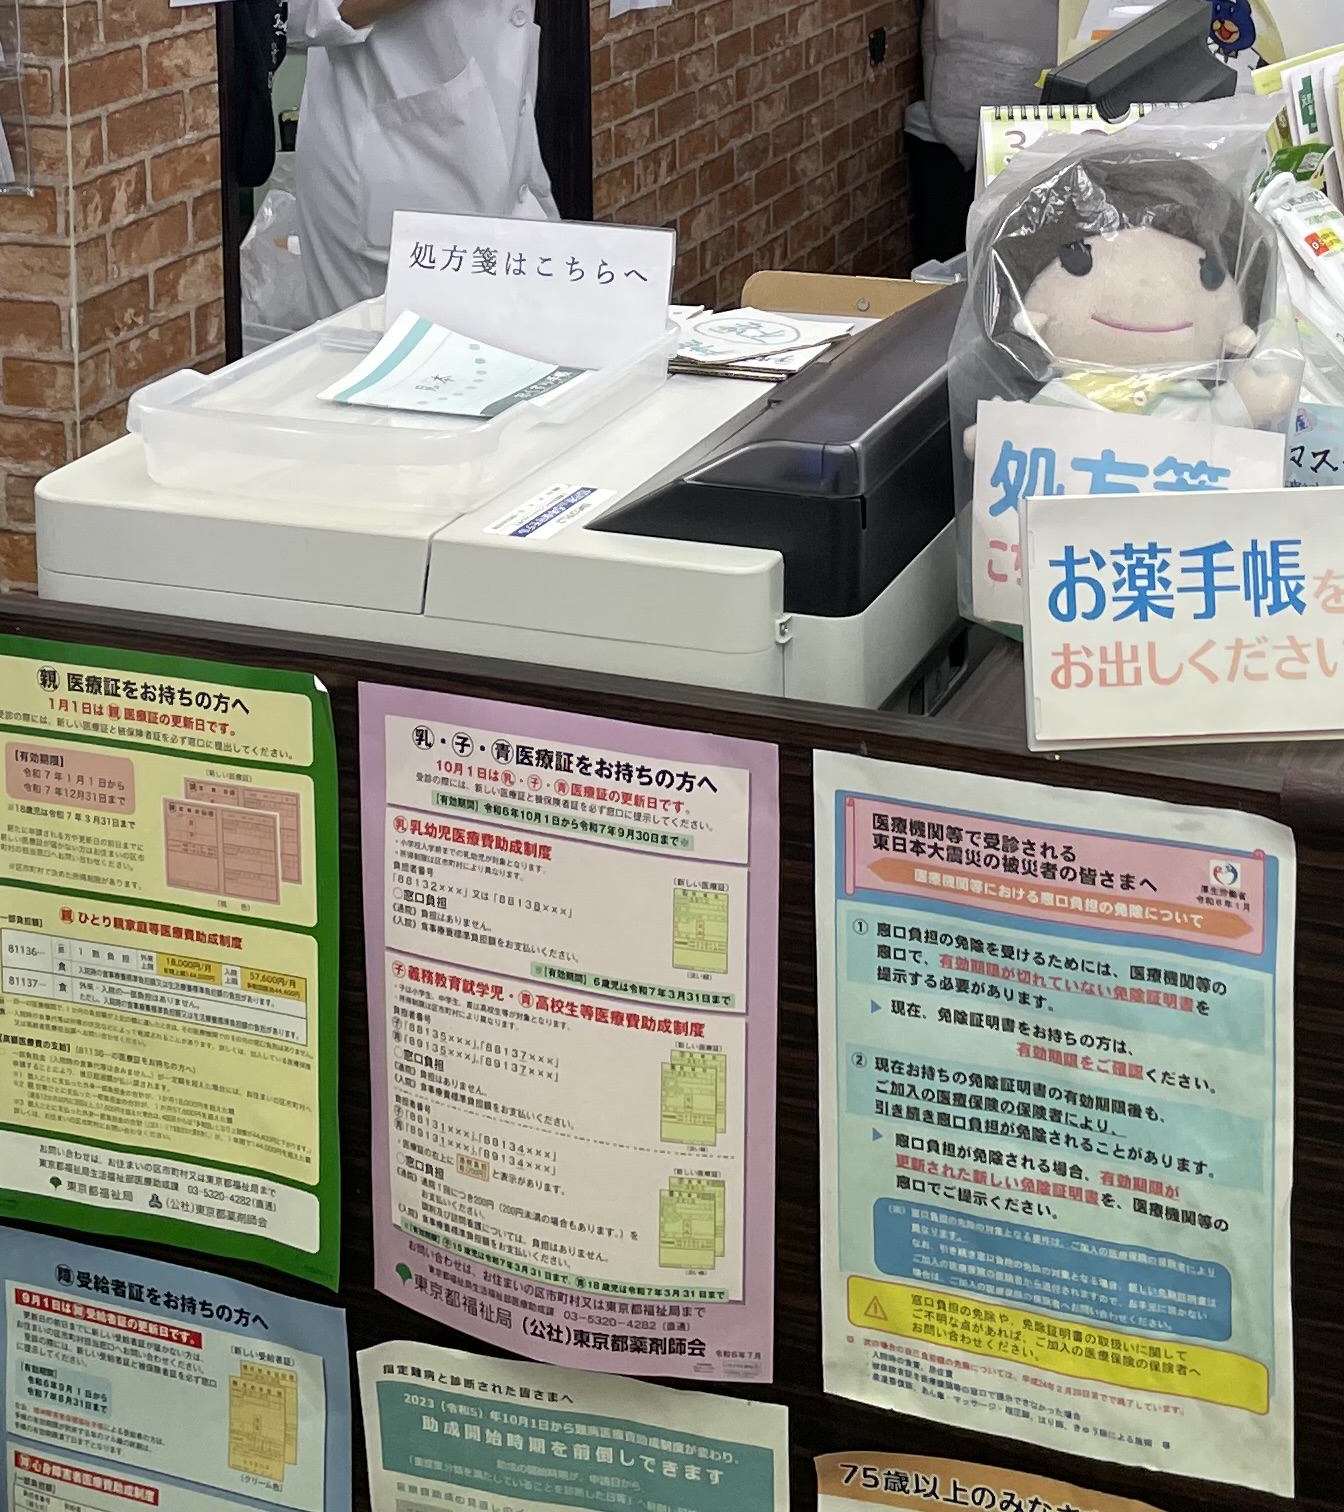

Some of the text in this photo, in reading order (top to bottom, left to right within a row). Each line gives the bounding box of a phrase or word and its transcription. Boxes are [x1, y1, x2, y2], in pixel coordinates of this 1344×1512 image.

[409, 241, 648, 285] 処方箋はこちらへ
[66, 671, 250, 717] 医療証をお持ちの方へ
[871, 812, 1077, 863] 医療機関等で受診される
[871, 833, 1158, 893] 東日本大震災の被災者の皆さまへ
[876, 966, 1056, 1012] 提示する必要があります。
[76, 1271, 270, 1331] 受給者証をお持ちの方へ
[414, 1273, 707, 1358] 東京都福祉局 (公社)東京都薬剤師会
[421, 1414, 725, 1486] 助成開始時期を前倒しできます
